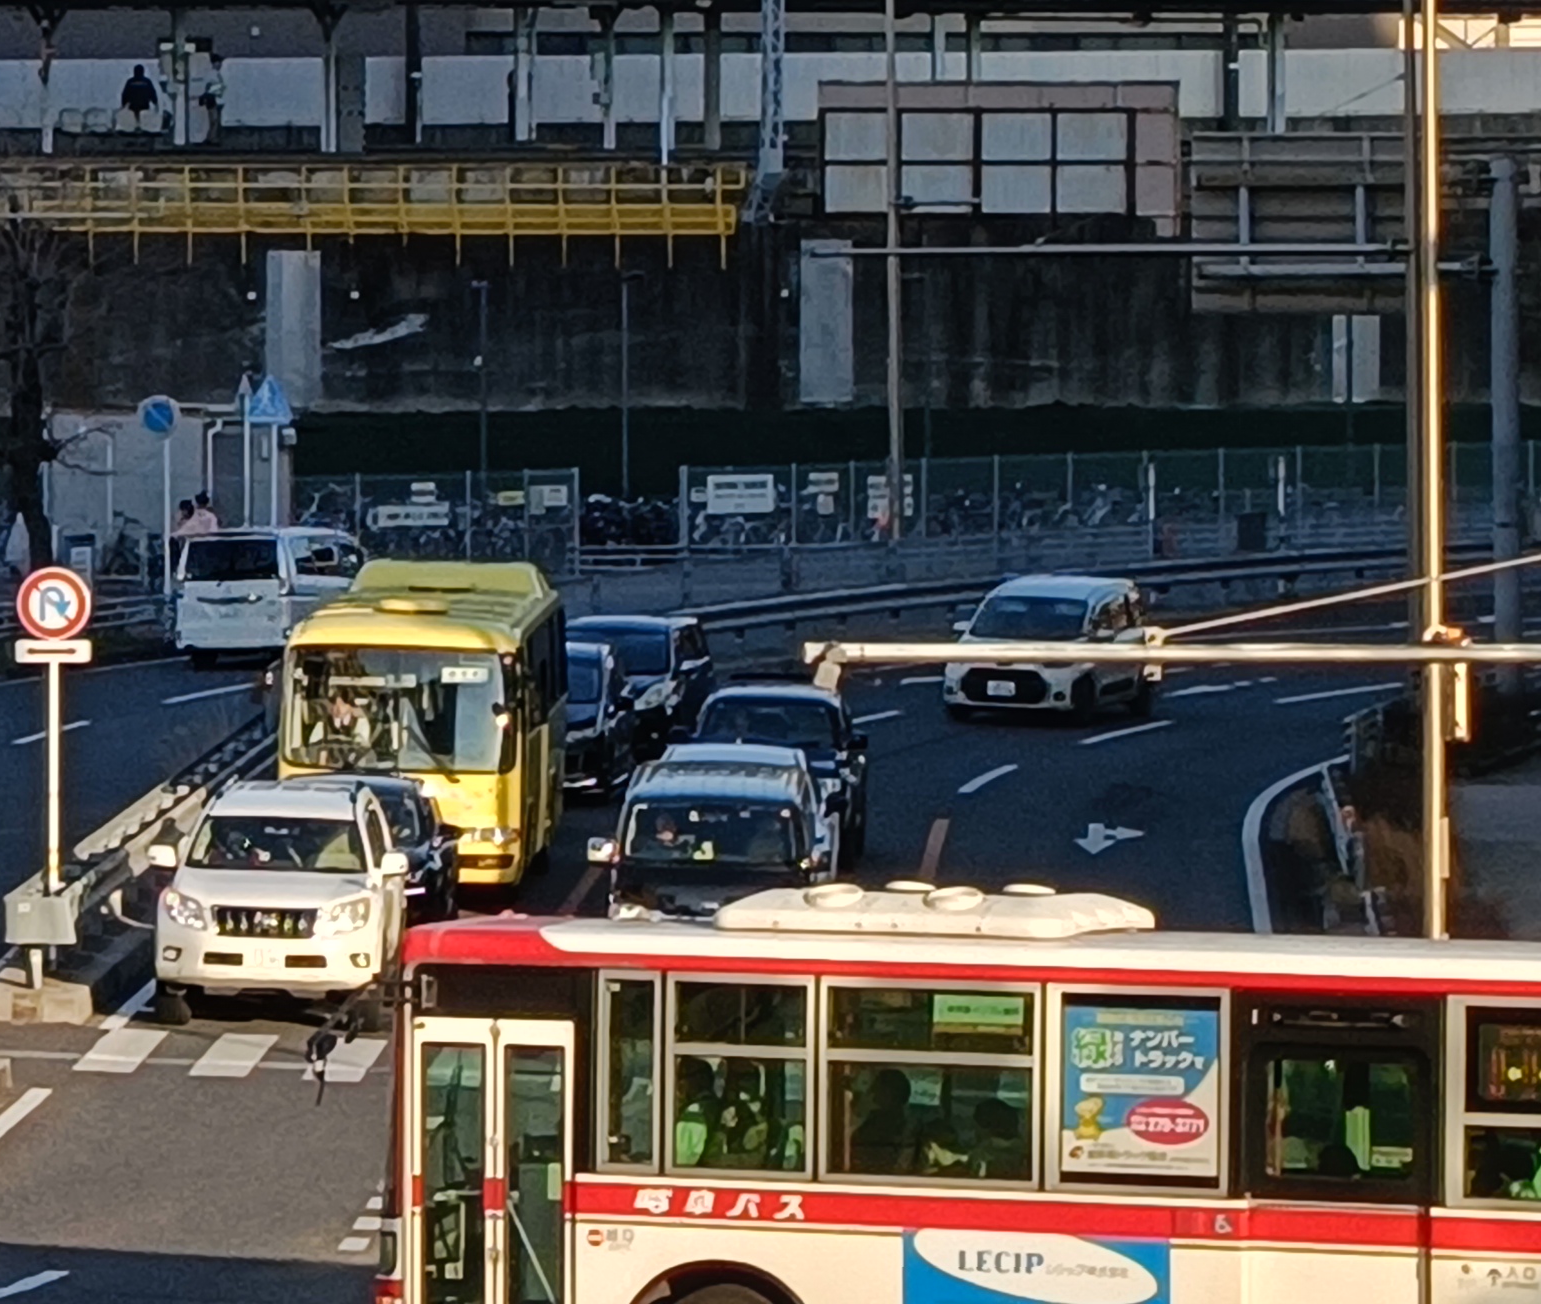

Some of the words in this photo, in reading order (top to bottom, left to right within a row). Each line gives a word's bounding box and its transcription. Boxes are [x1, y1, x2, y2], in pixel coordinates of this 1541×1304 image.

[1129, 1029, 1196, 1048] ナンバー
[958, 1249, 1045, 1275] LECIP
